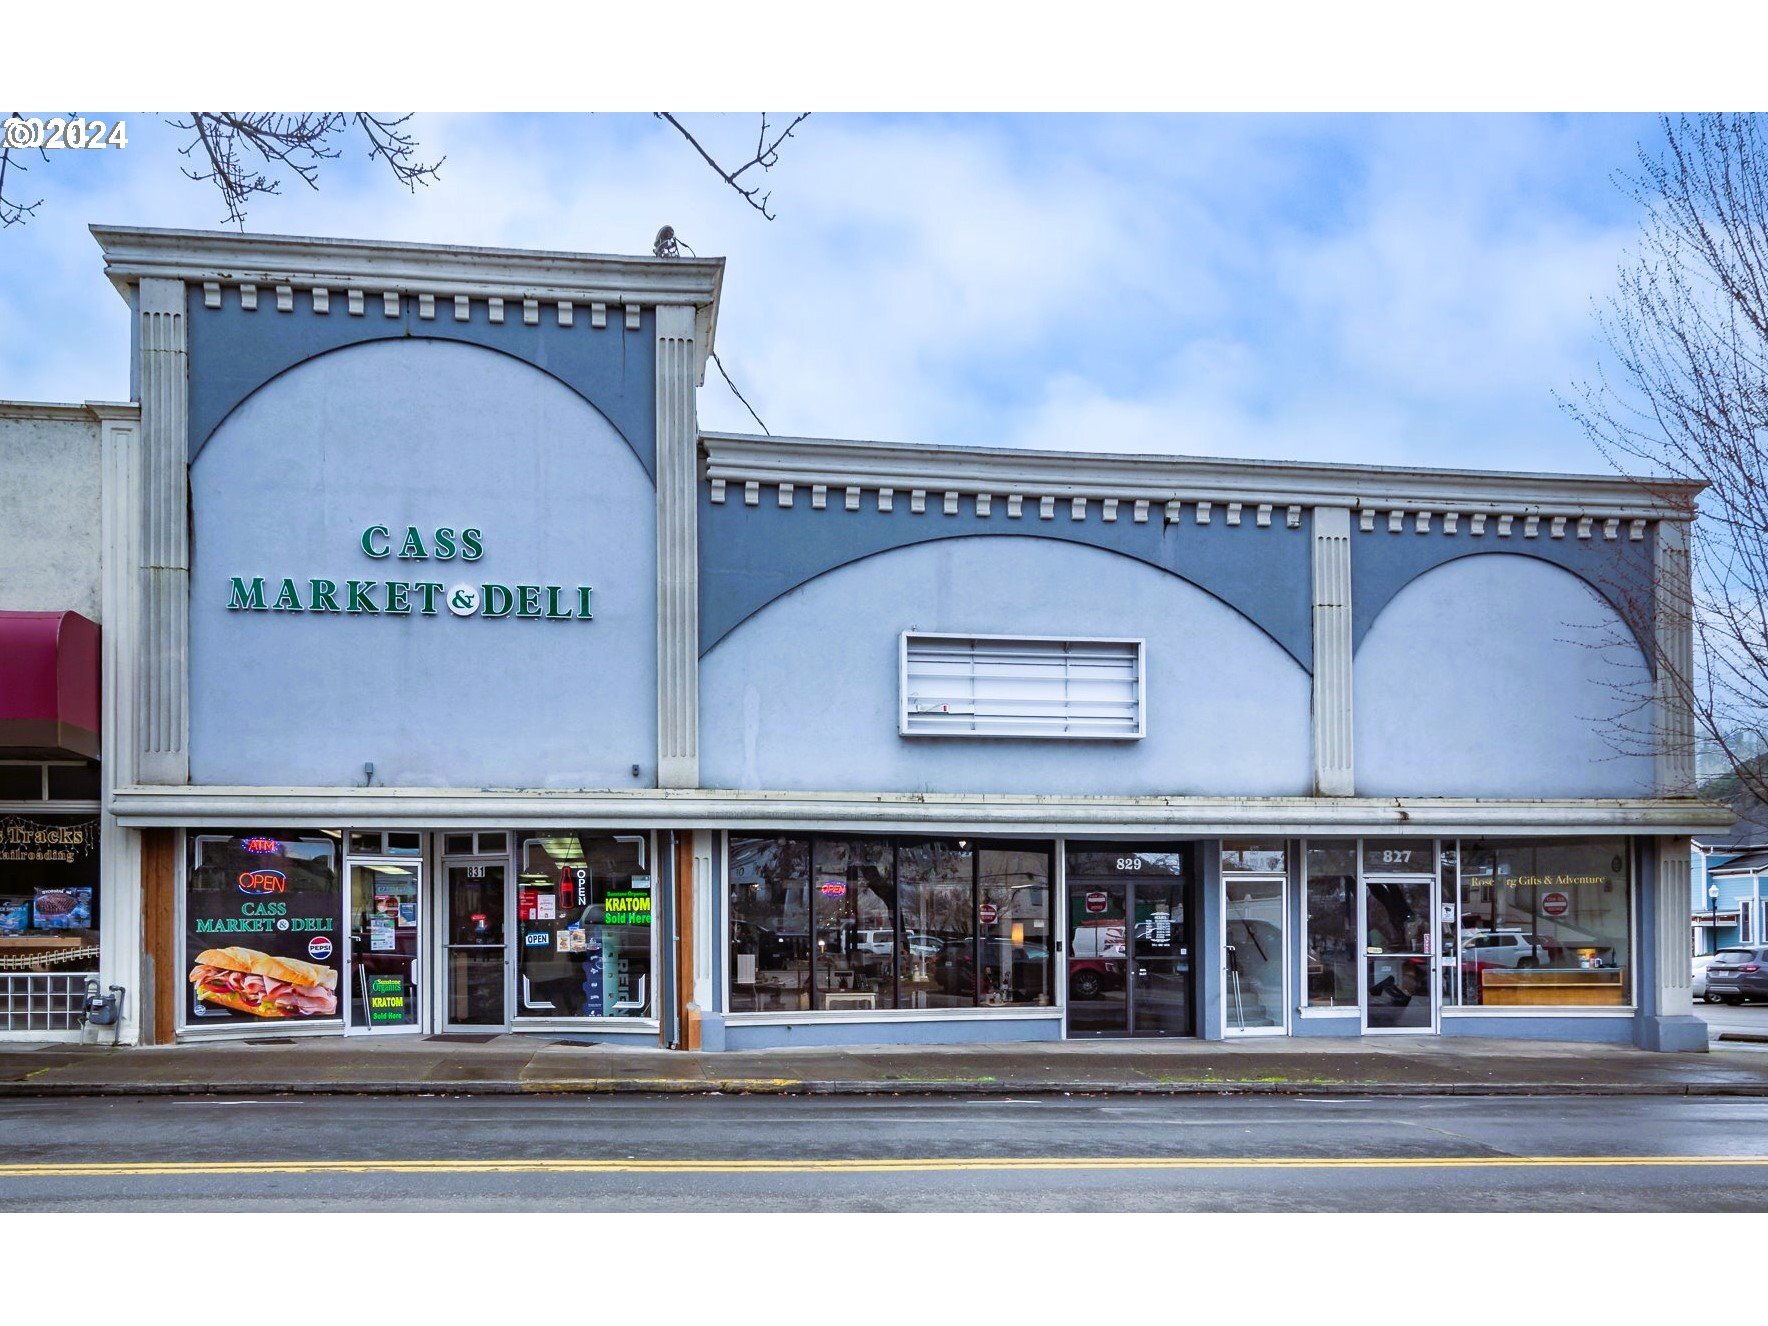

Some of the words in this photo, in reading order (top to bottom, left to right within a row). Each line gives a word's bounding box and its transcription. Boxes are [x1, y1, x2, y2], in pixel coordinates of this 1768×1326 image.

[360, 524, 484, 561] CASS
[226, 576, 444, 615] MARKET
[449, 587, 477, 612] &
[481, 583, 593, 620] DELI
[7, 827, 83, 844] Tracks
[249, 840, 275, 851] ATM
[1383, 850, 1411, 863] 827
[1116, 858, 1142, 870] 829
[468, 866, 485, 877] 831
[239, 872, 286, 893] OPEN
[1519, 875, 1542, 885] Gifts
[1544, 876, 1552, 885] &
[577, 870, 586, 906] OPEN
[822, 884, 846, 895] OPEN
[241, 902, 287, 916] CASS
[605, 898, 650, 911] KRATOM
[605, 912, 626, 924] Sold
[628, 912, 652, 924] Here
[196, 919, 275, 933] MARKET
[291, 918, 333, 931] DELI
[527, 935, 547, 943] OPEN
[372, 997, 404, 1008] KRATOM
[373, 1012, 388, 1020] Sold
